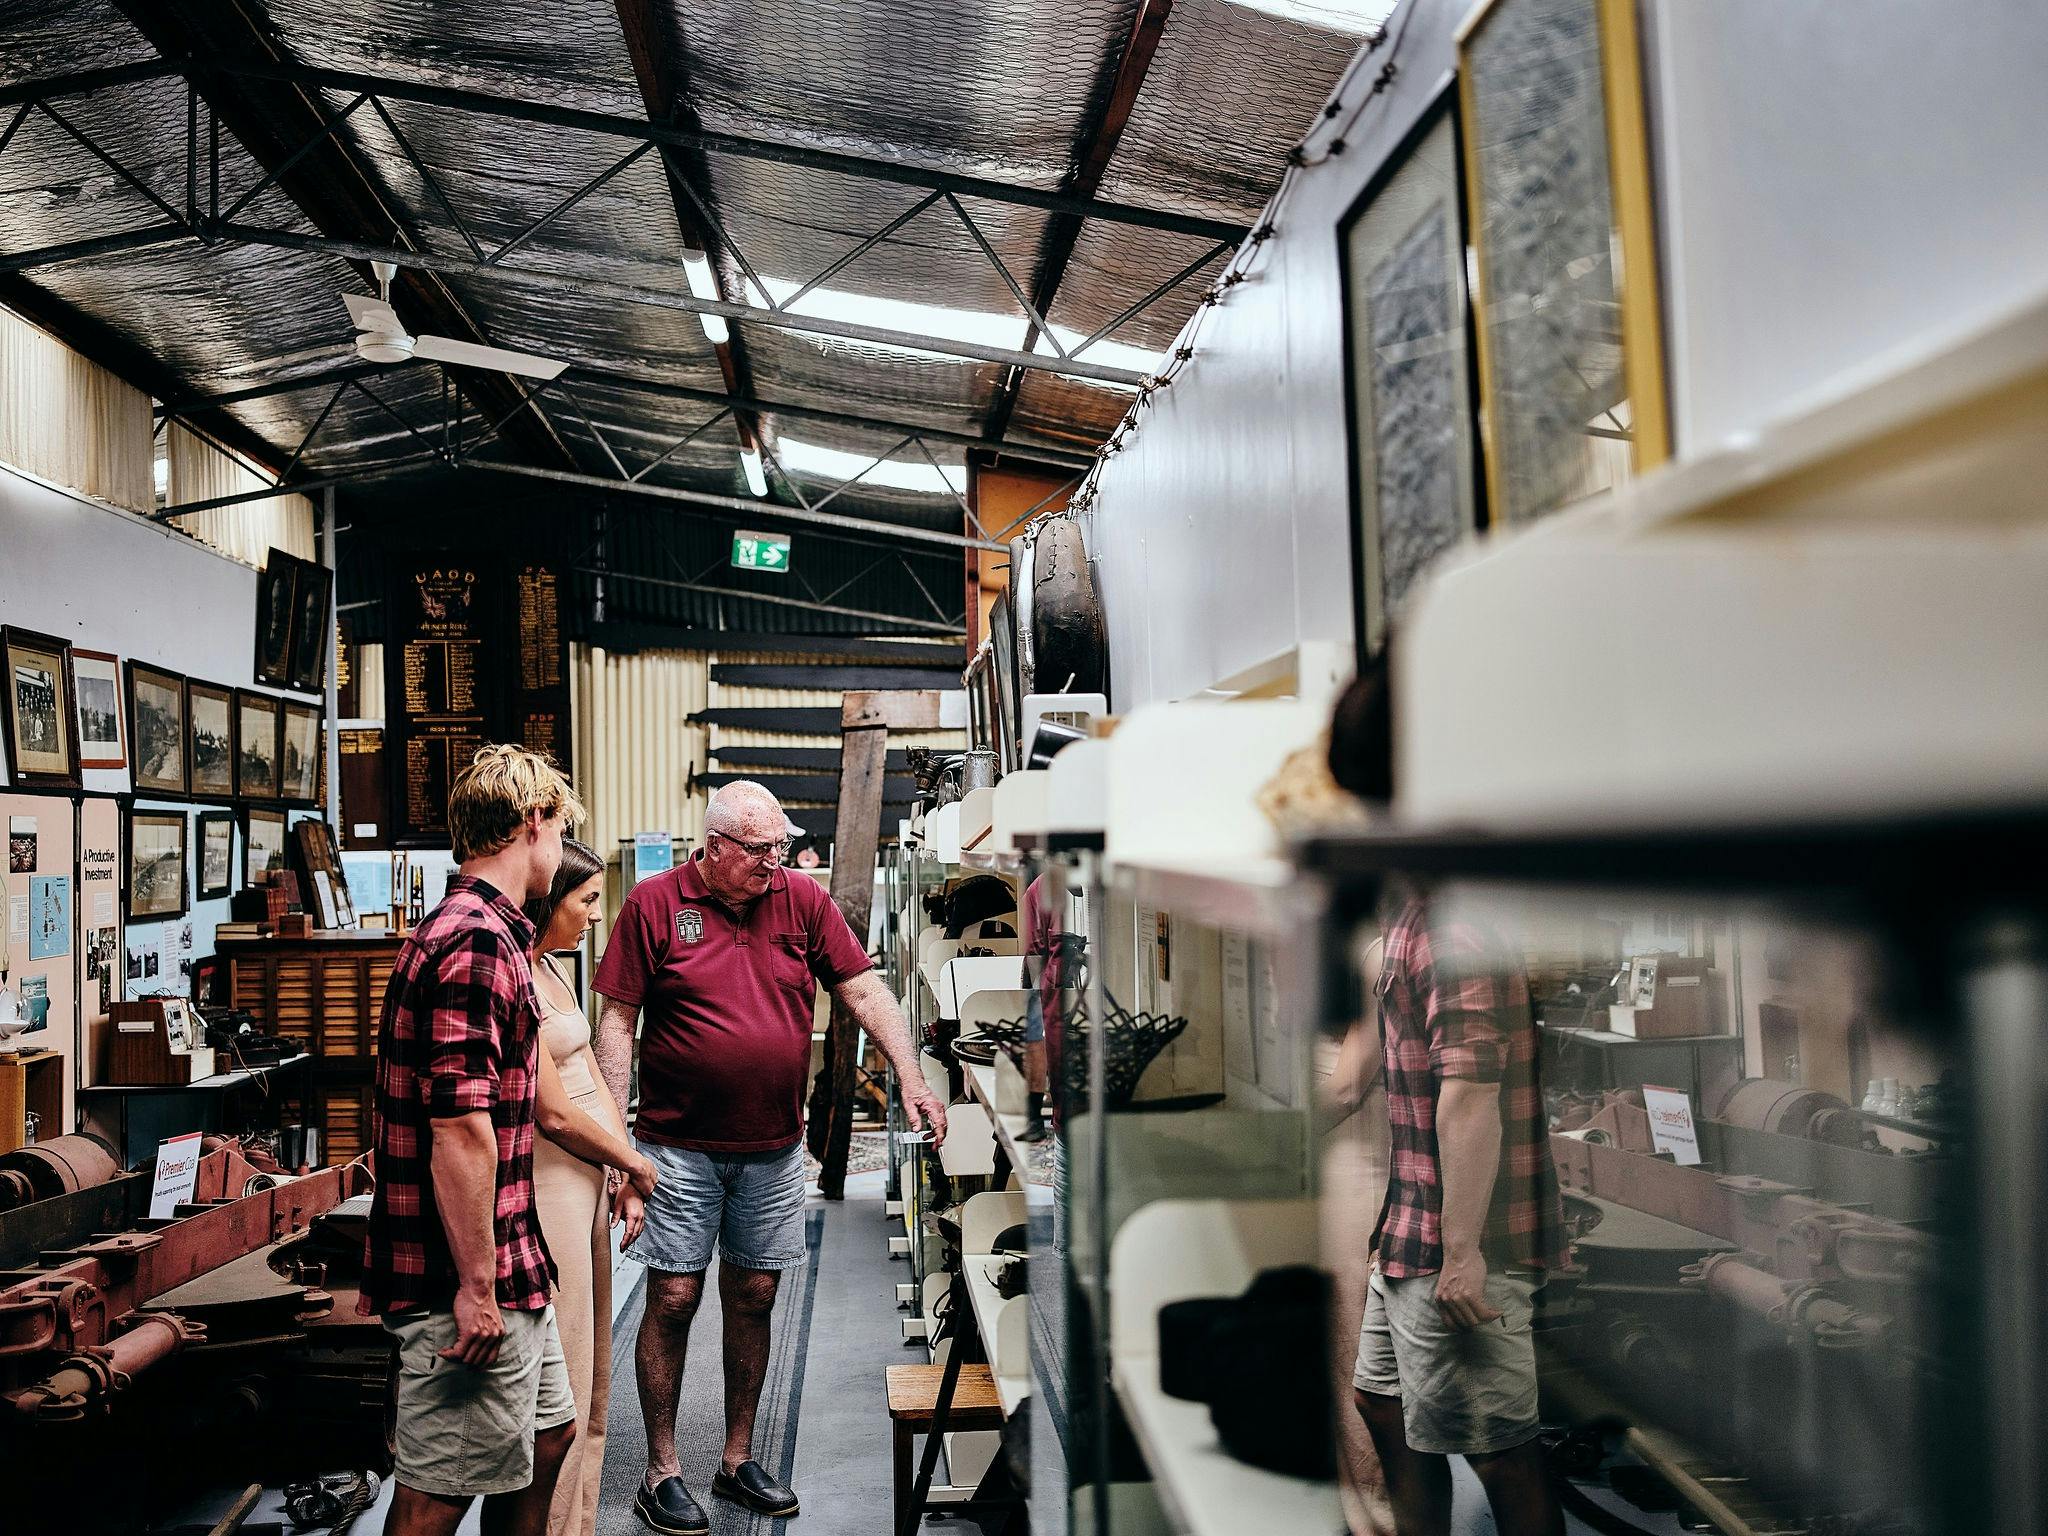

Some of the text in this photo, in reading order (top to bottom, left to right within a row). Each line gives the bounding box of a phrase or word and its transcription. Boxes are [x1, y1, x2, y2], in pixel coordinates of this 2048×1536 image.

[83, 849, 115, 862] A Productive
[84, 867, 113, 880] Investment
[165, 1160, 186, 1176] Premier
